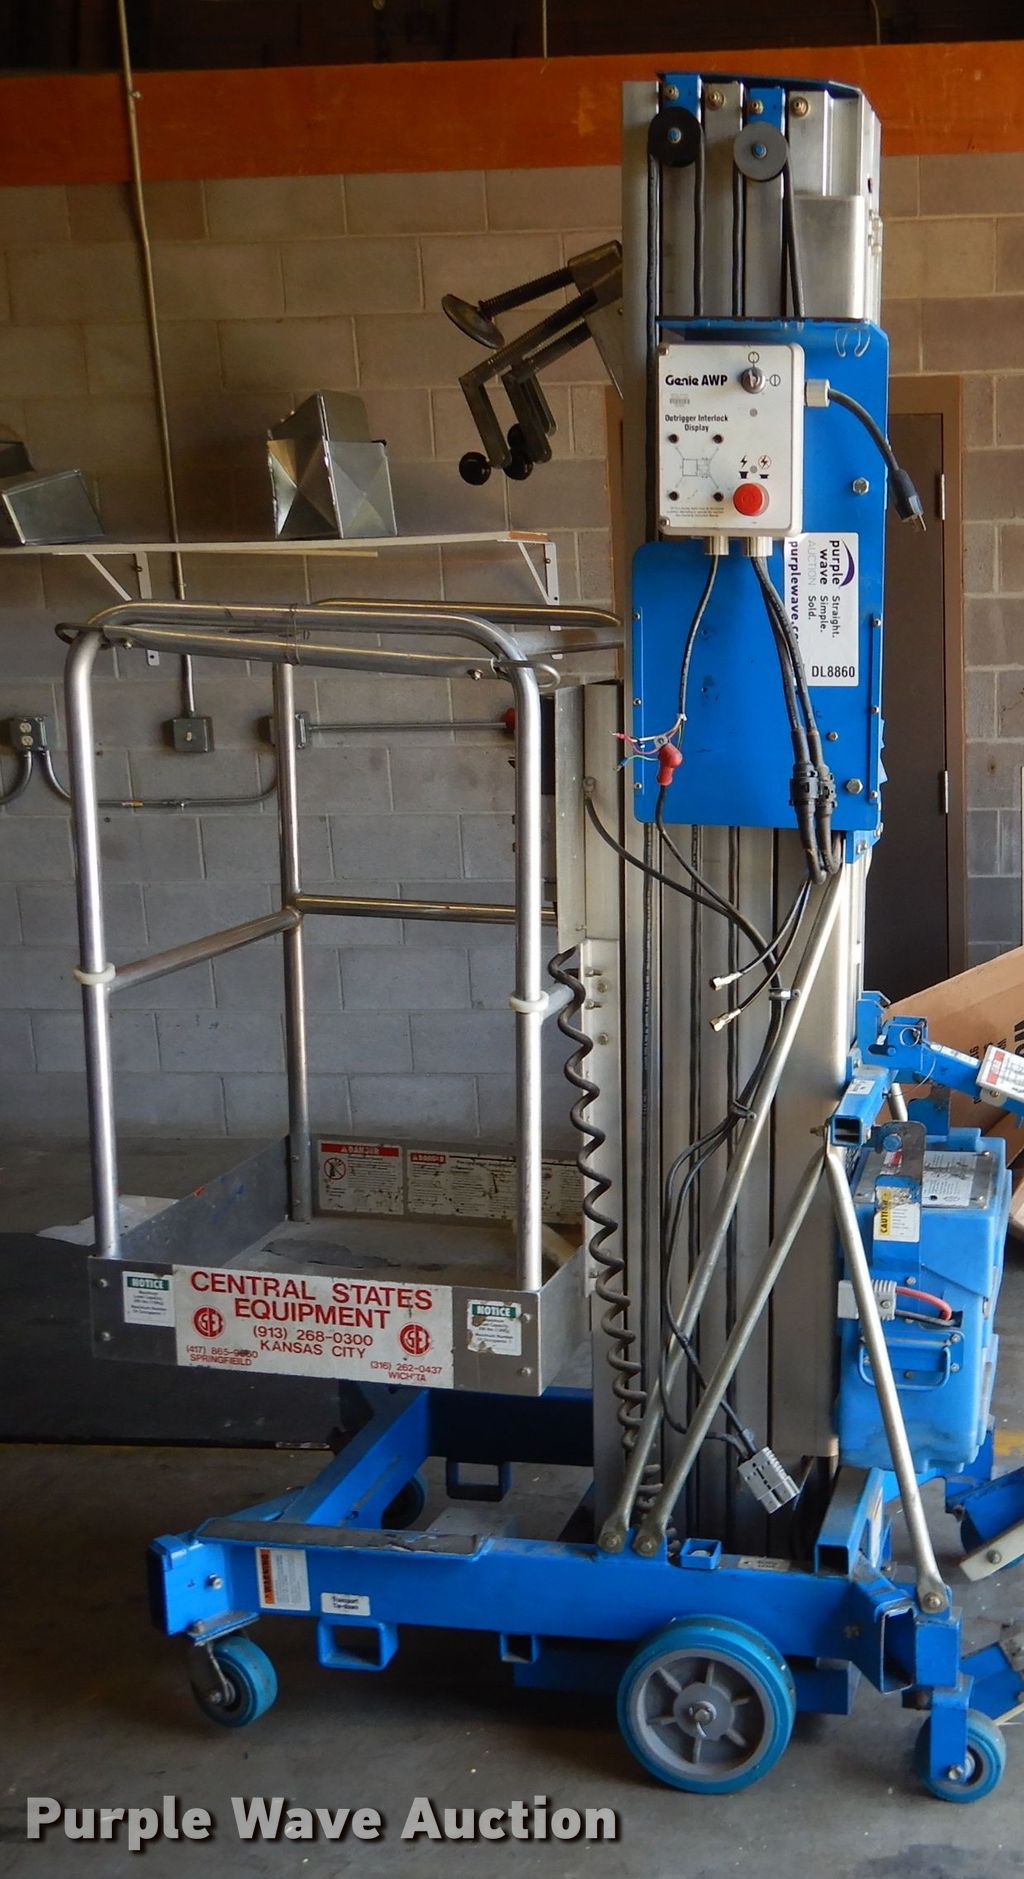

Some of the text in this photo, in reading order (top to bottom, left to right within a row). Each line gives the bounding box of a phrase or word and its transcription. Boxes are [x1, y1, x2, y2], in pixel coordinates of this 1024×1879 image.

[665, 375, 728, 386] Genie AWP
[665, 414, 728, 423] Outrigger Interlock
[684, 424, 709, 432] Display
[808, 540, 817, 586] AUCTION
[820, 549, 828, 585] wave
[829, 540, 843, 585] purple
[788, 541, 800, 643] purplewave.co
[808, 595, 816, 620] Sold.
[818, 595, 828, 633] Simple.
[830, 595, 840, 638] Straight.
[811, 666, 856, 678] DL8860
[132, 1278, 164, 1289] NOTICE
[191, 1270, 432, 1310] CENTRAL STATES
[235, 1297, 391, 1329] EQUIPMENT
[477, 1305, 511, 1316] NOTICE
[253, 1325, 374, 1346] (913) 268-0300
[260, 1340, 367, 1358] KANSAS CITY
[370, 1361, 443, 1374] (316) 262-0437
